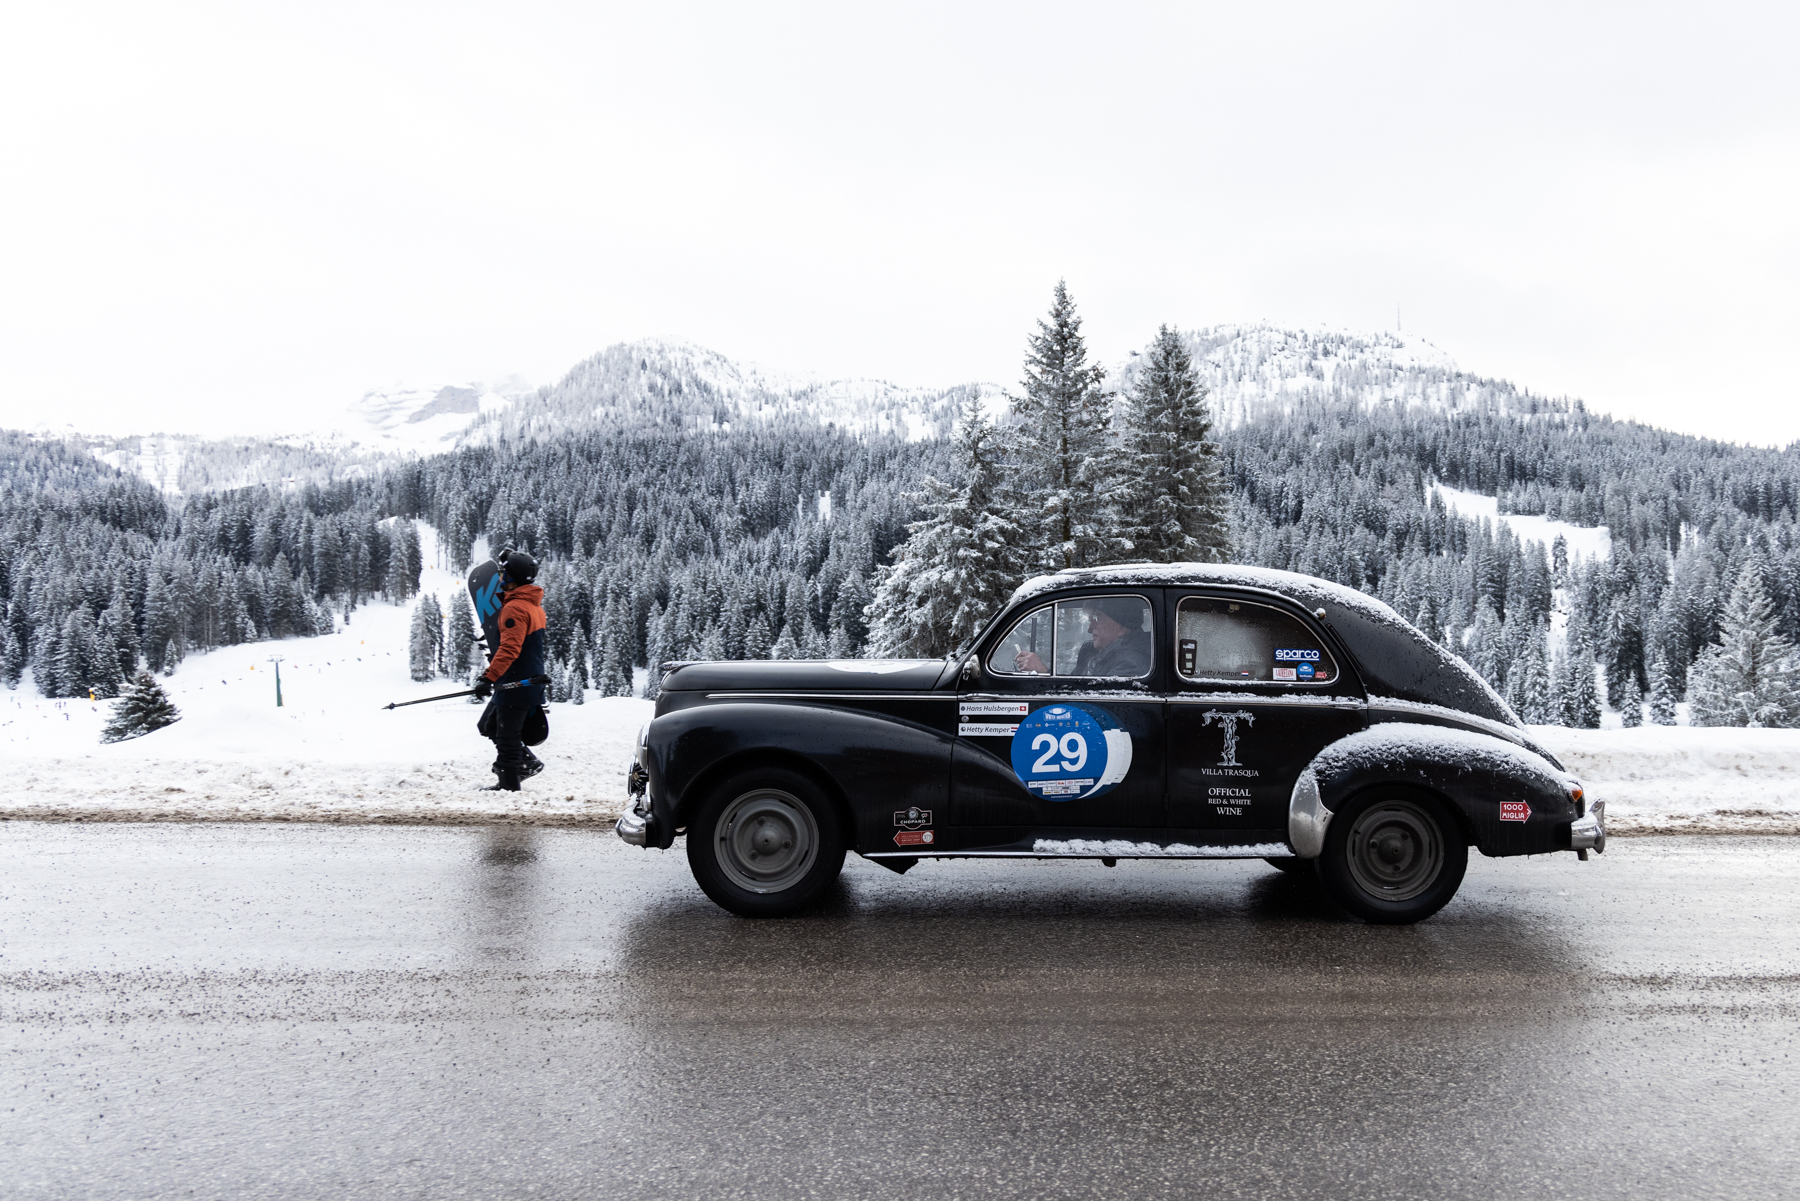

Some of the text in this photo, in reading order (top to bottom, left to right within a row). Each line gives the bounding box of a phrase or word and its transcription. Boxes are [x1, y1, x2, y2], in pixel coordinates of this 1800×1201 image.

[1275, 649, 1319, 661] sparco
[983, 705, 1019, 713] Hulsbergen
[1032, 732, 1088, 773] 29
[1224, 768, 1260, 778] TRASQUA
[1208, 788, 1252, 796] OFFICIAL
[1216, 807, 1242, 816] WINE
